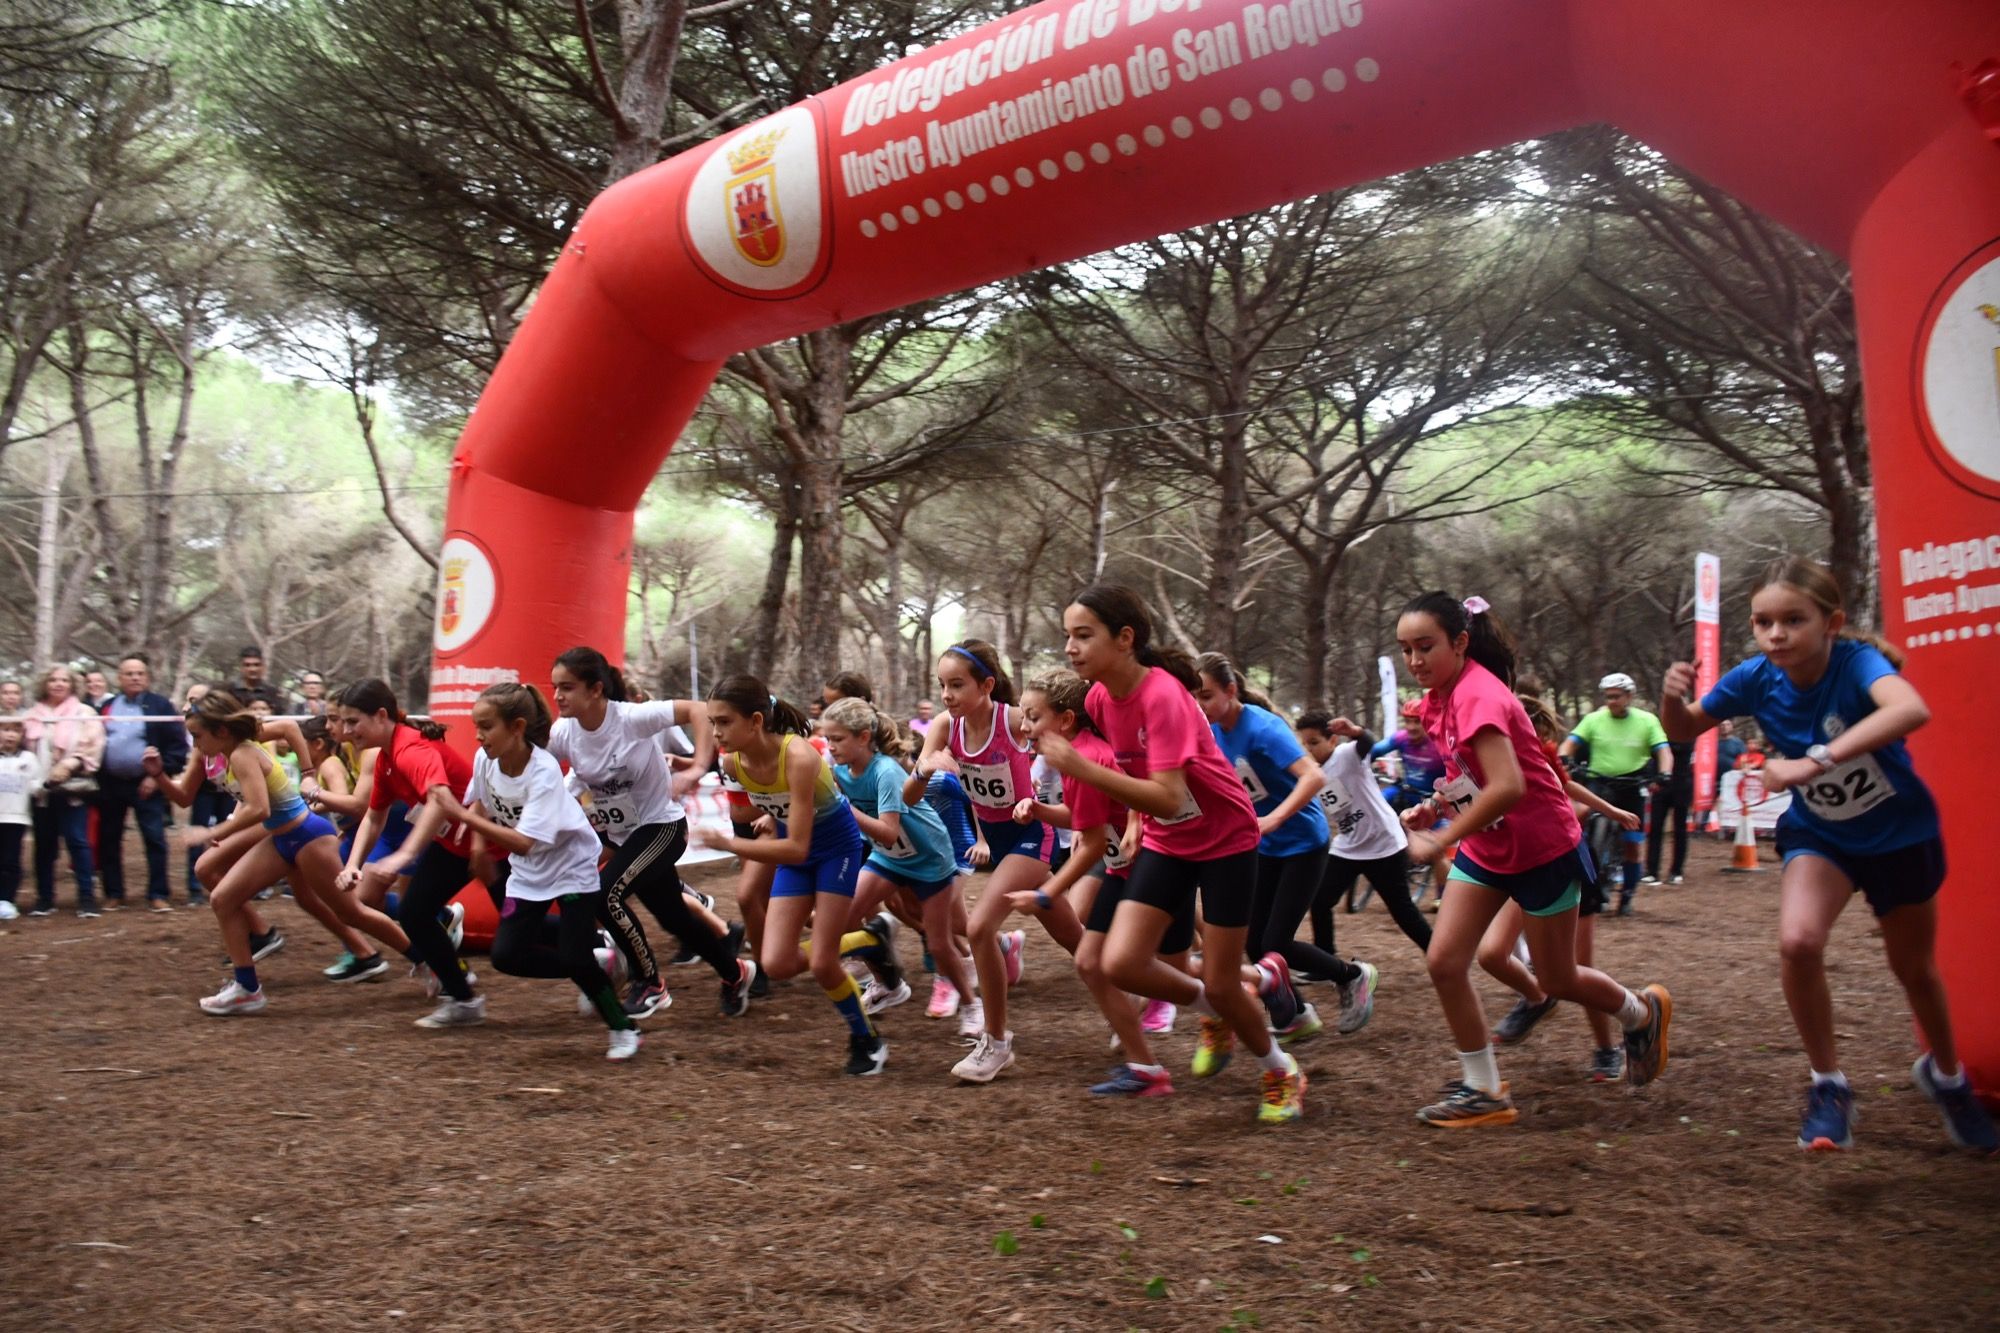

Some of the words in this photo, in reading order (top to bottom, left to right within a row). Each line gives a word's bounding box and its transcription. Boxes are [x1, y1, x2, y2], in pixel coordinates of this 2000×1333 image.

[841, 13, 1060, 136] Delegación
[1063, 0, 1120, 49] de
[840, 135, 926, 197] Ilustre
[926, 63, 1125, 168] Ayuntamiento
[1126, 43, 1171, 98] de
[1172, 21, 1242, 82] San
[1243, 0, 1364, 59] Roque
[960, 773, 1006, 798] 166
[589, 807, 625, 826] 299
[608, 877, 629, 921] SPORT
[620, 922, 656, 978] SUPERDAY
